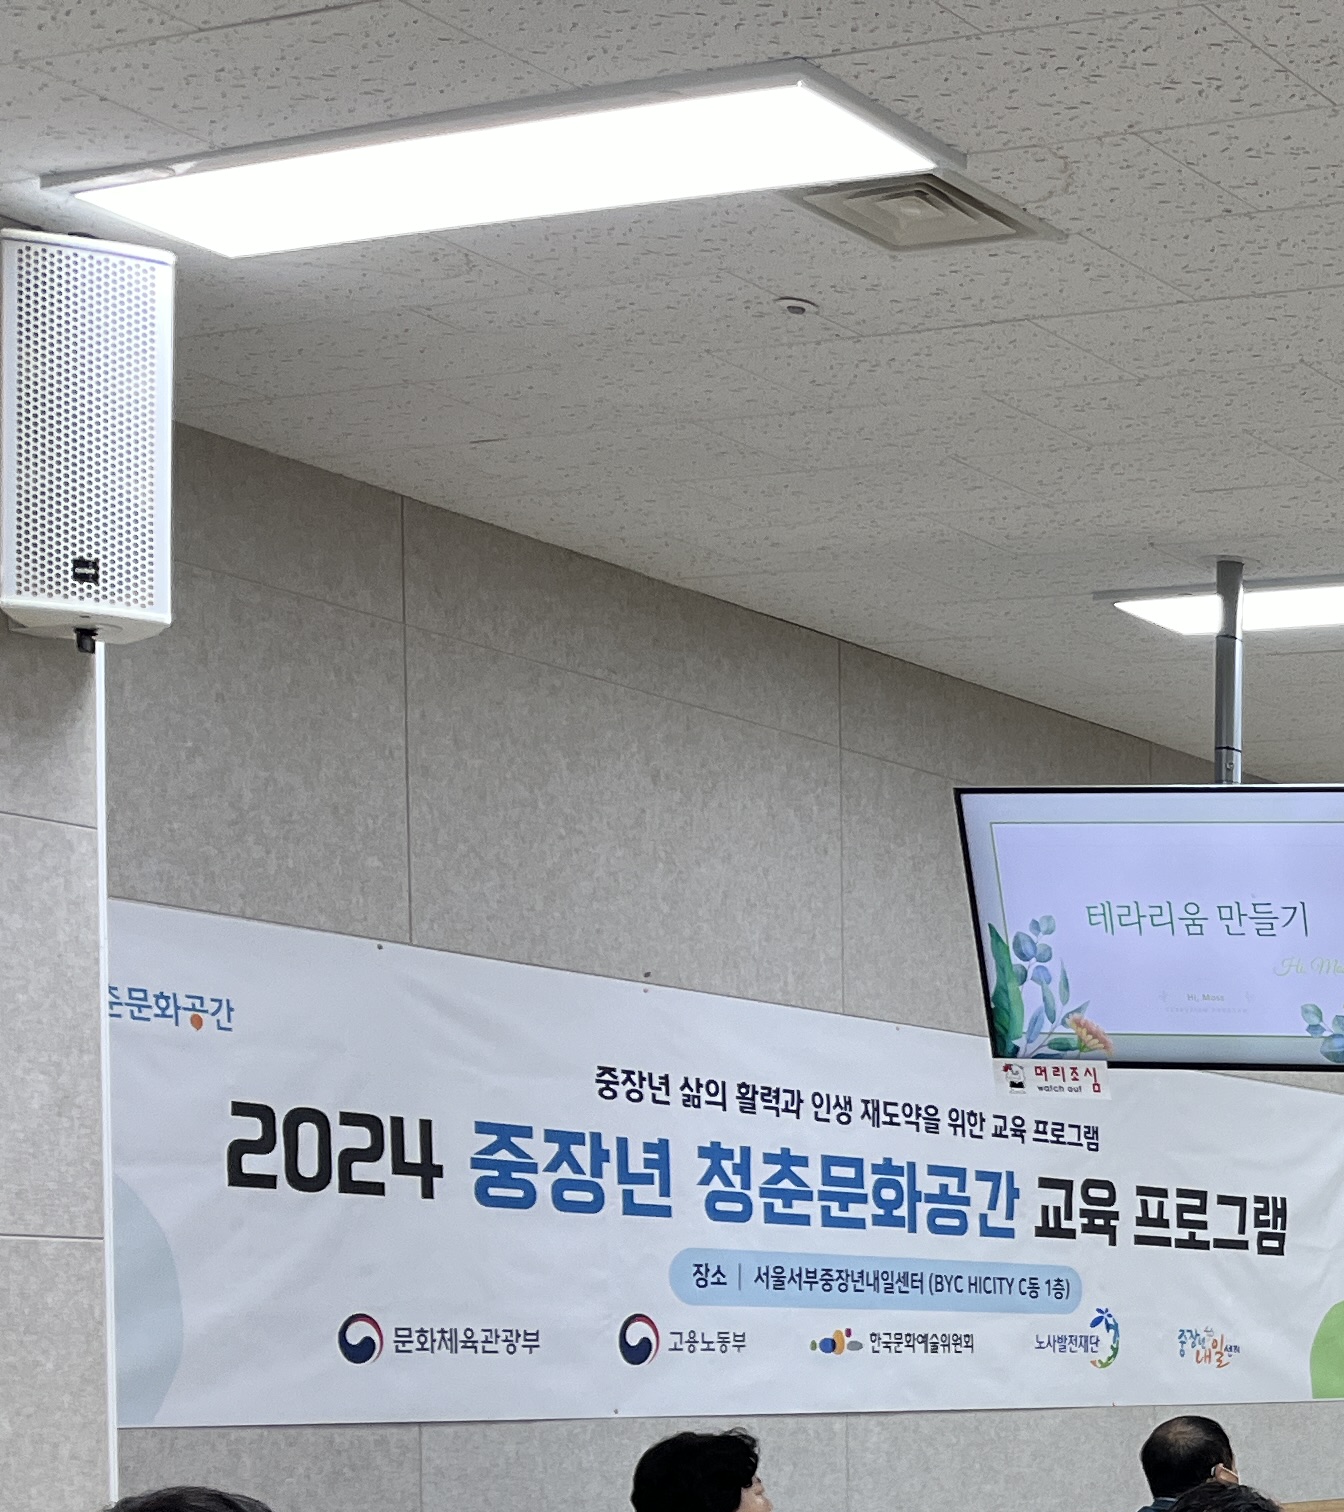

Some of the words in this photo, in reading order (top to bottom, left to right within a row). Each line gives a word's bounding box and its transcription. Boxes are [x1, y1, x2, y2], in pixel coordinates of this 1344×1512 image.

[1085, 899, 1209, 937] 테라리움
[1217, 899, 1310, 938] 만들기
[1034, 1065, 1101, 1093] 머리조심
[1036, 1084, 1065, 1093] watch
[595, 1065, 671, 1106] 중장년
[679, 1076, 727, 1111] 삶의
[735, 1081, 804, 1119] 활력과
[811, 1091, 853, 1126] 인생
[860, 1098, 941, 1135] 재도약을
[947, 1107, 986, 1140] 위한
[991, 1114, 1027, 1145] 교육
[1032, 1119, 1100, 1152] 프로그램
[226, 1100, 444, 1200] 2024
[469, 1120, 673, 1218] 중장년
[696, 1140, 1020, 1240] 청춘문화공간
[1033, 1176, 1120, 1248] 교육
[1133, 1185, 1288, 1257] 프로그램
[692, 1262, 728, 1289] 장소
[753, 1264, 924, 1295] 서울서부중장년내일센터
[928, 1272, 964, 1296] (BYC
[967, 1275, 1015, 1296] HICITY
[1018, 1276, 1041, 1299] C동
[1044, 1276, 1071, 1300] 1층)
[392, 1326, 542, 1356] 문화체육관광부
[666, 1329, 747, 1354] 고용노동부
[869, 1331, 975, 1354] 한국문화예술위원회
[1034, 1333, 1101, 1354] 노사발전재단
